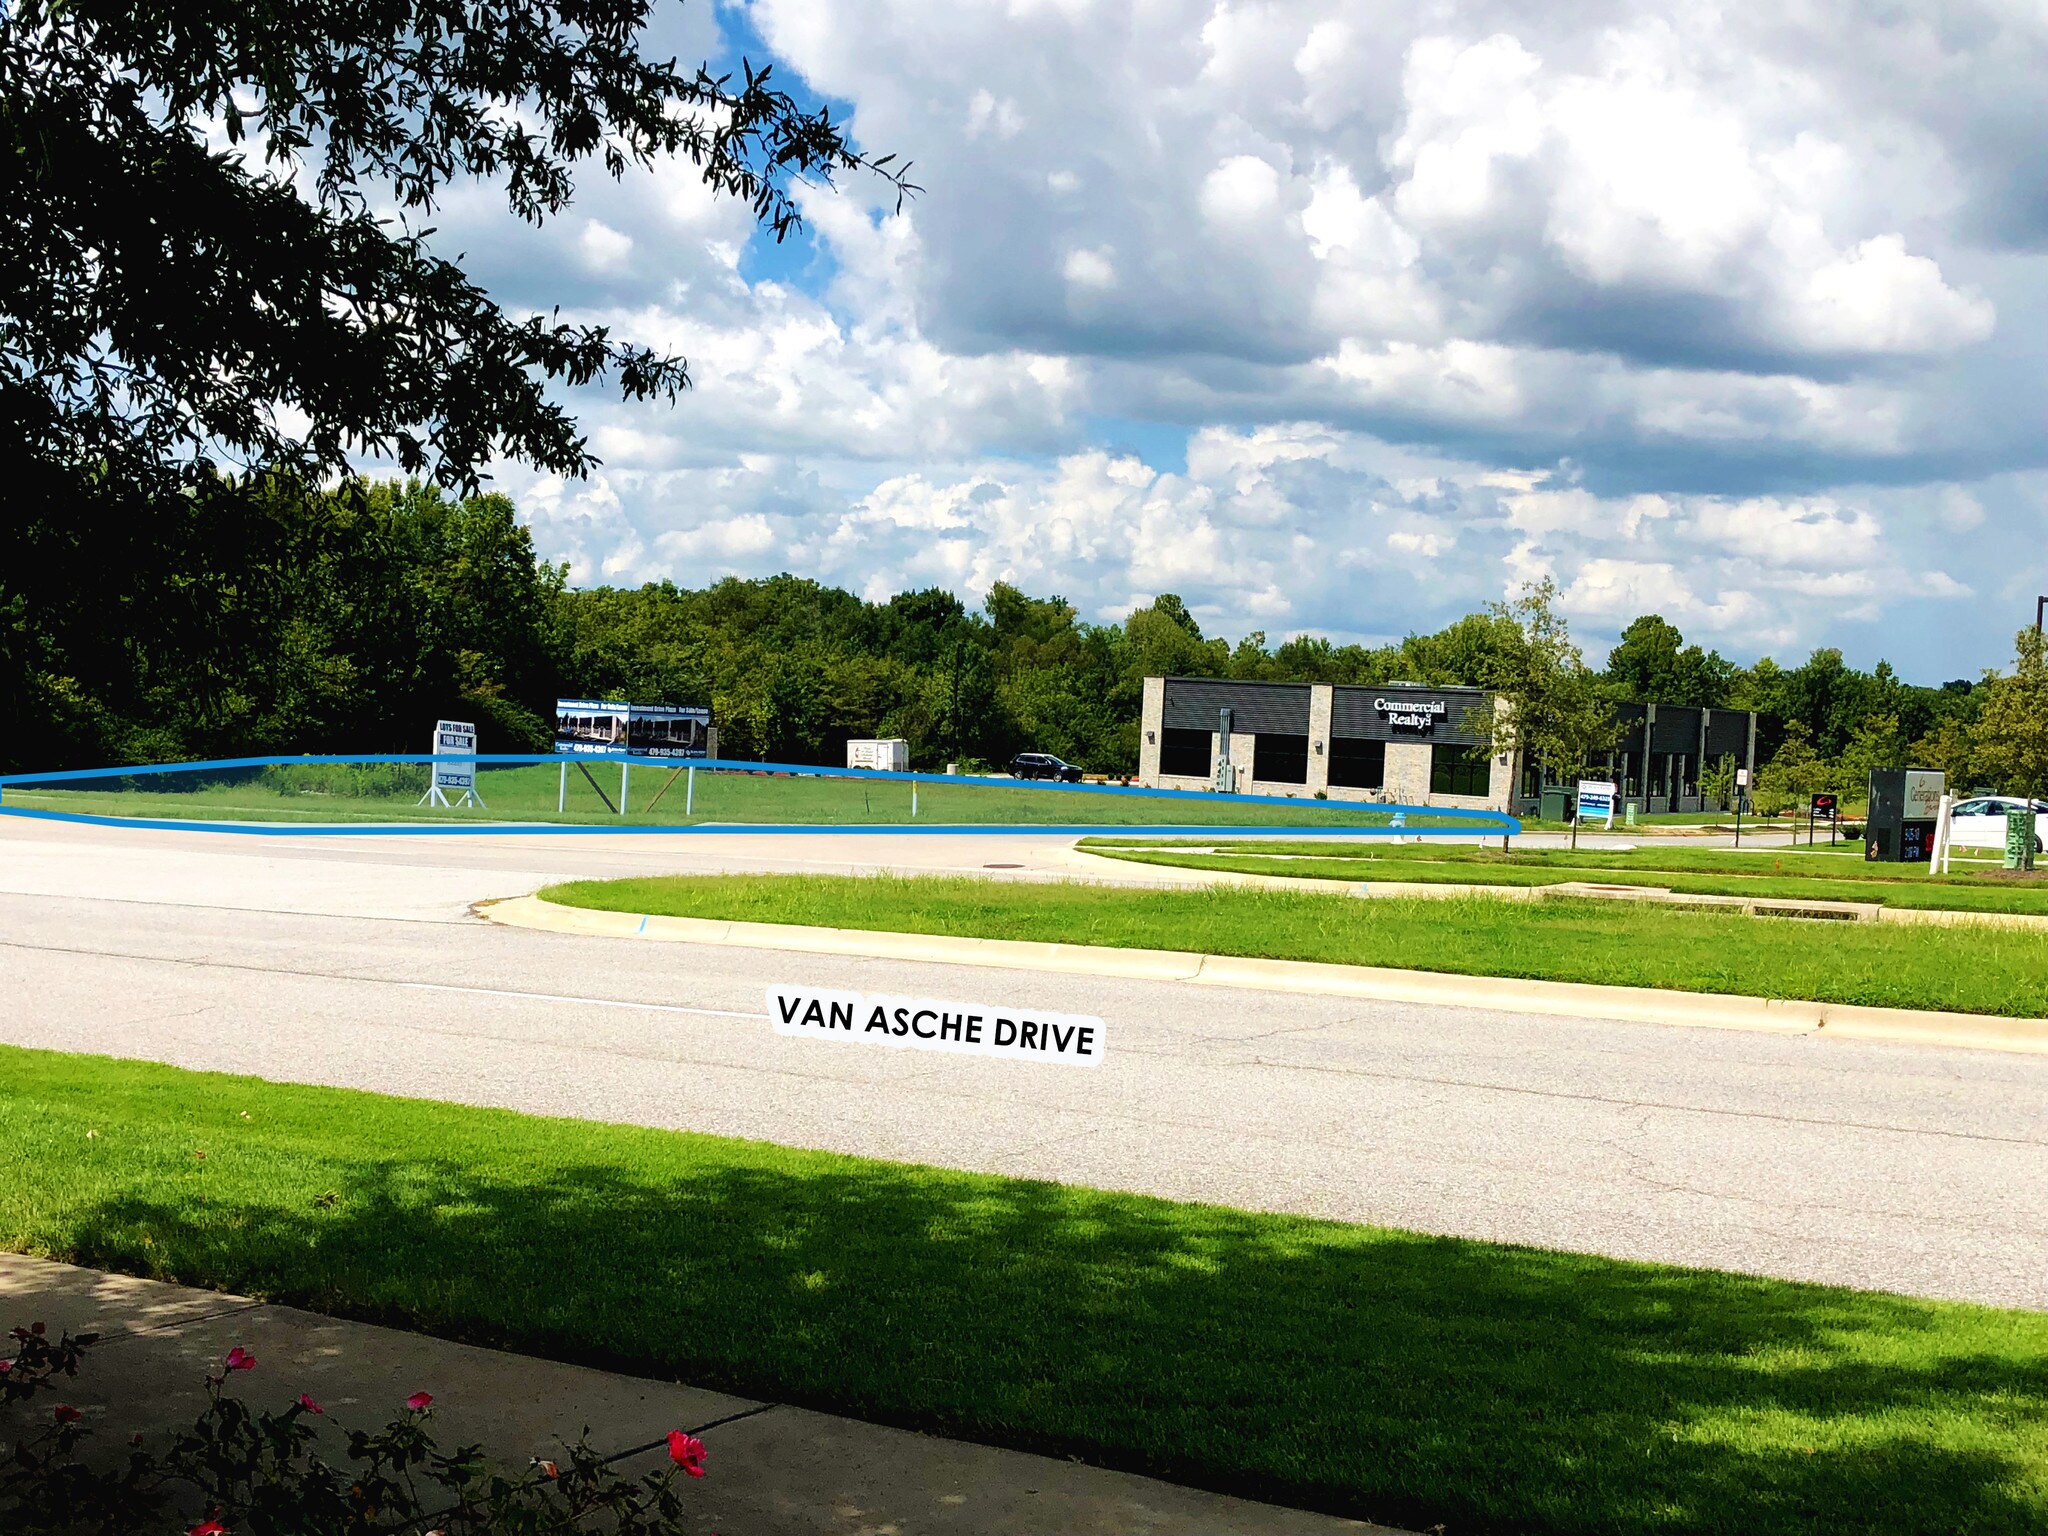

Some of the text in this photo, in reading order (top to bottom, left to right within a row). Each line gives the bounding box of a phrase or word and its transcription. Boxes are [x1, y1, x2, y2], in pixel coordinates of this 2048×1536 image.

[1374, 698, 1446, 713] Commercial
[440, 722, 474, 733] LOTS FOR SALE
[1388, 713, 1426, 729] Realty
[443, 735, 468, 747] FOR SALE
